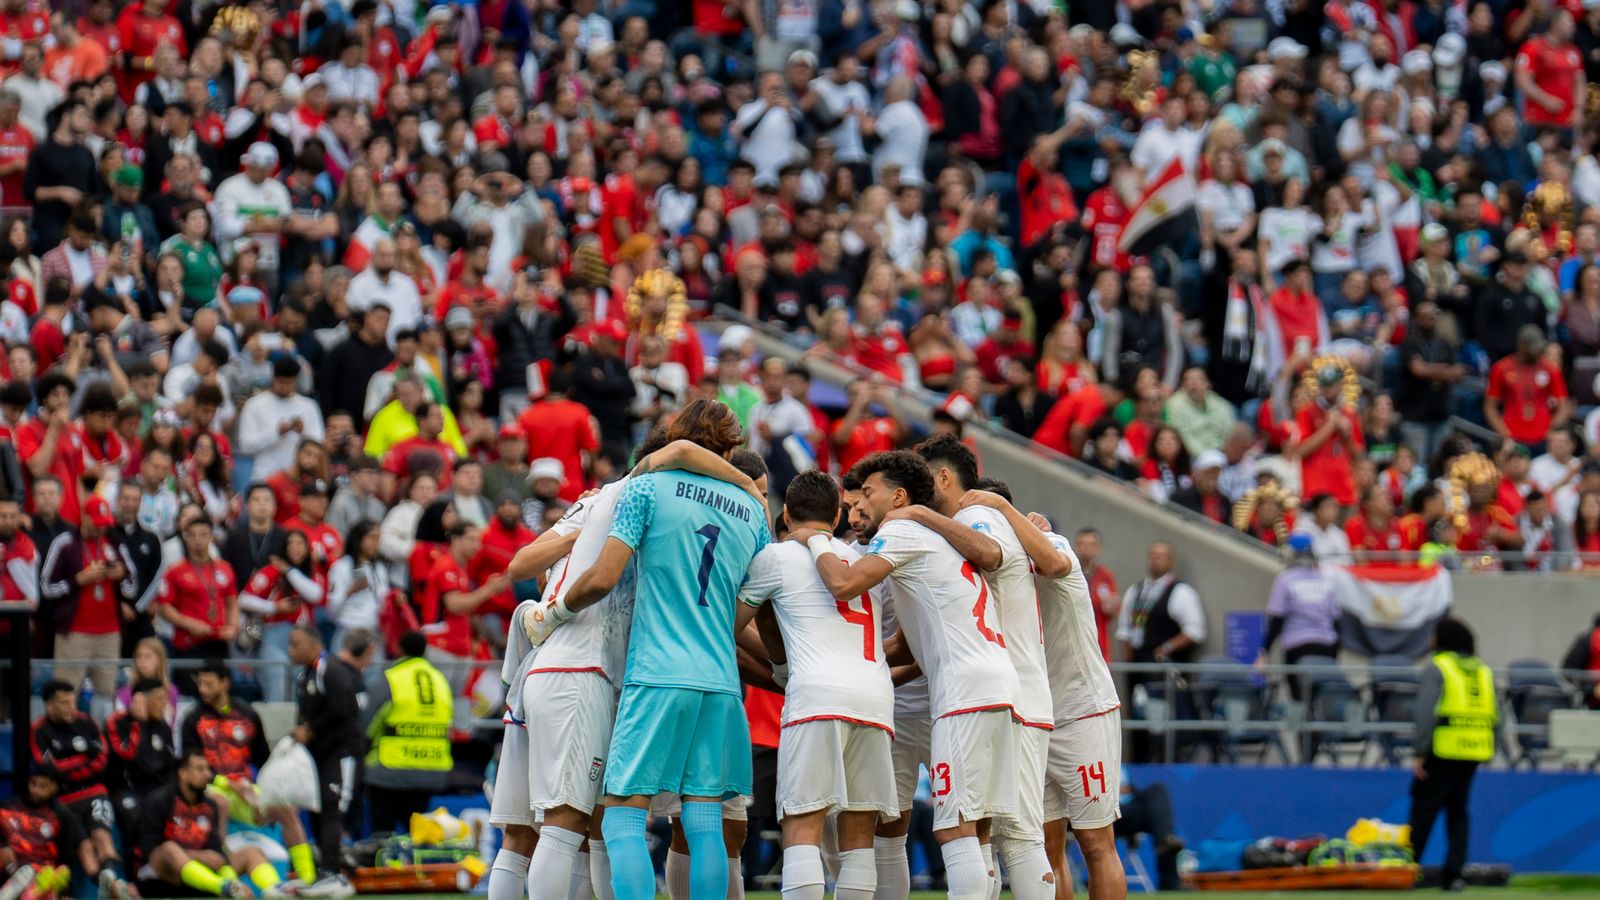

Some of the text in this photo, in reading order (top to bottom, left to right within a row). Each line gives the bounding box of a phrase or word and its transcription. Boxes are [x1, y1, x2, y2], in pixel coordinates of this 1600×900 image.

[675, 481, 751, 523] BEIRANVAND
[695, 523, 721, 608] 1
[960, 560, 1007, 649] 2
[1076, 761, 1106, 797] 14
